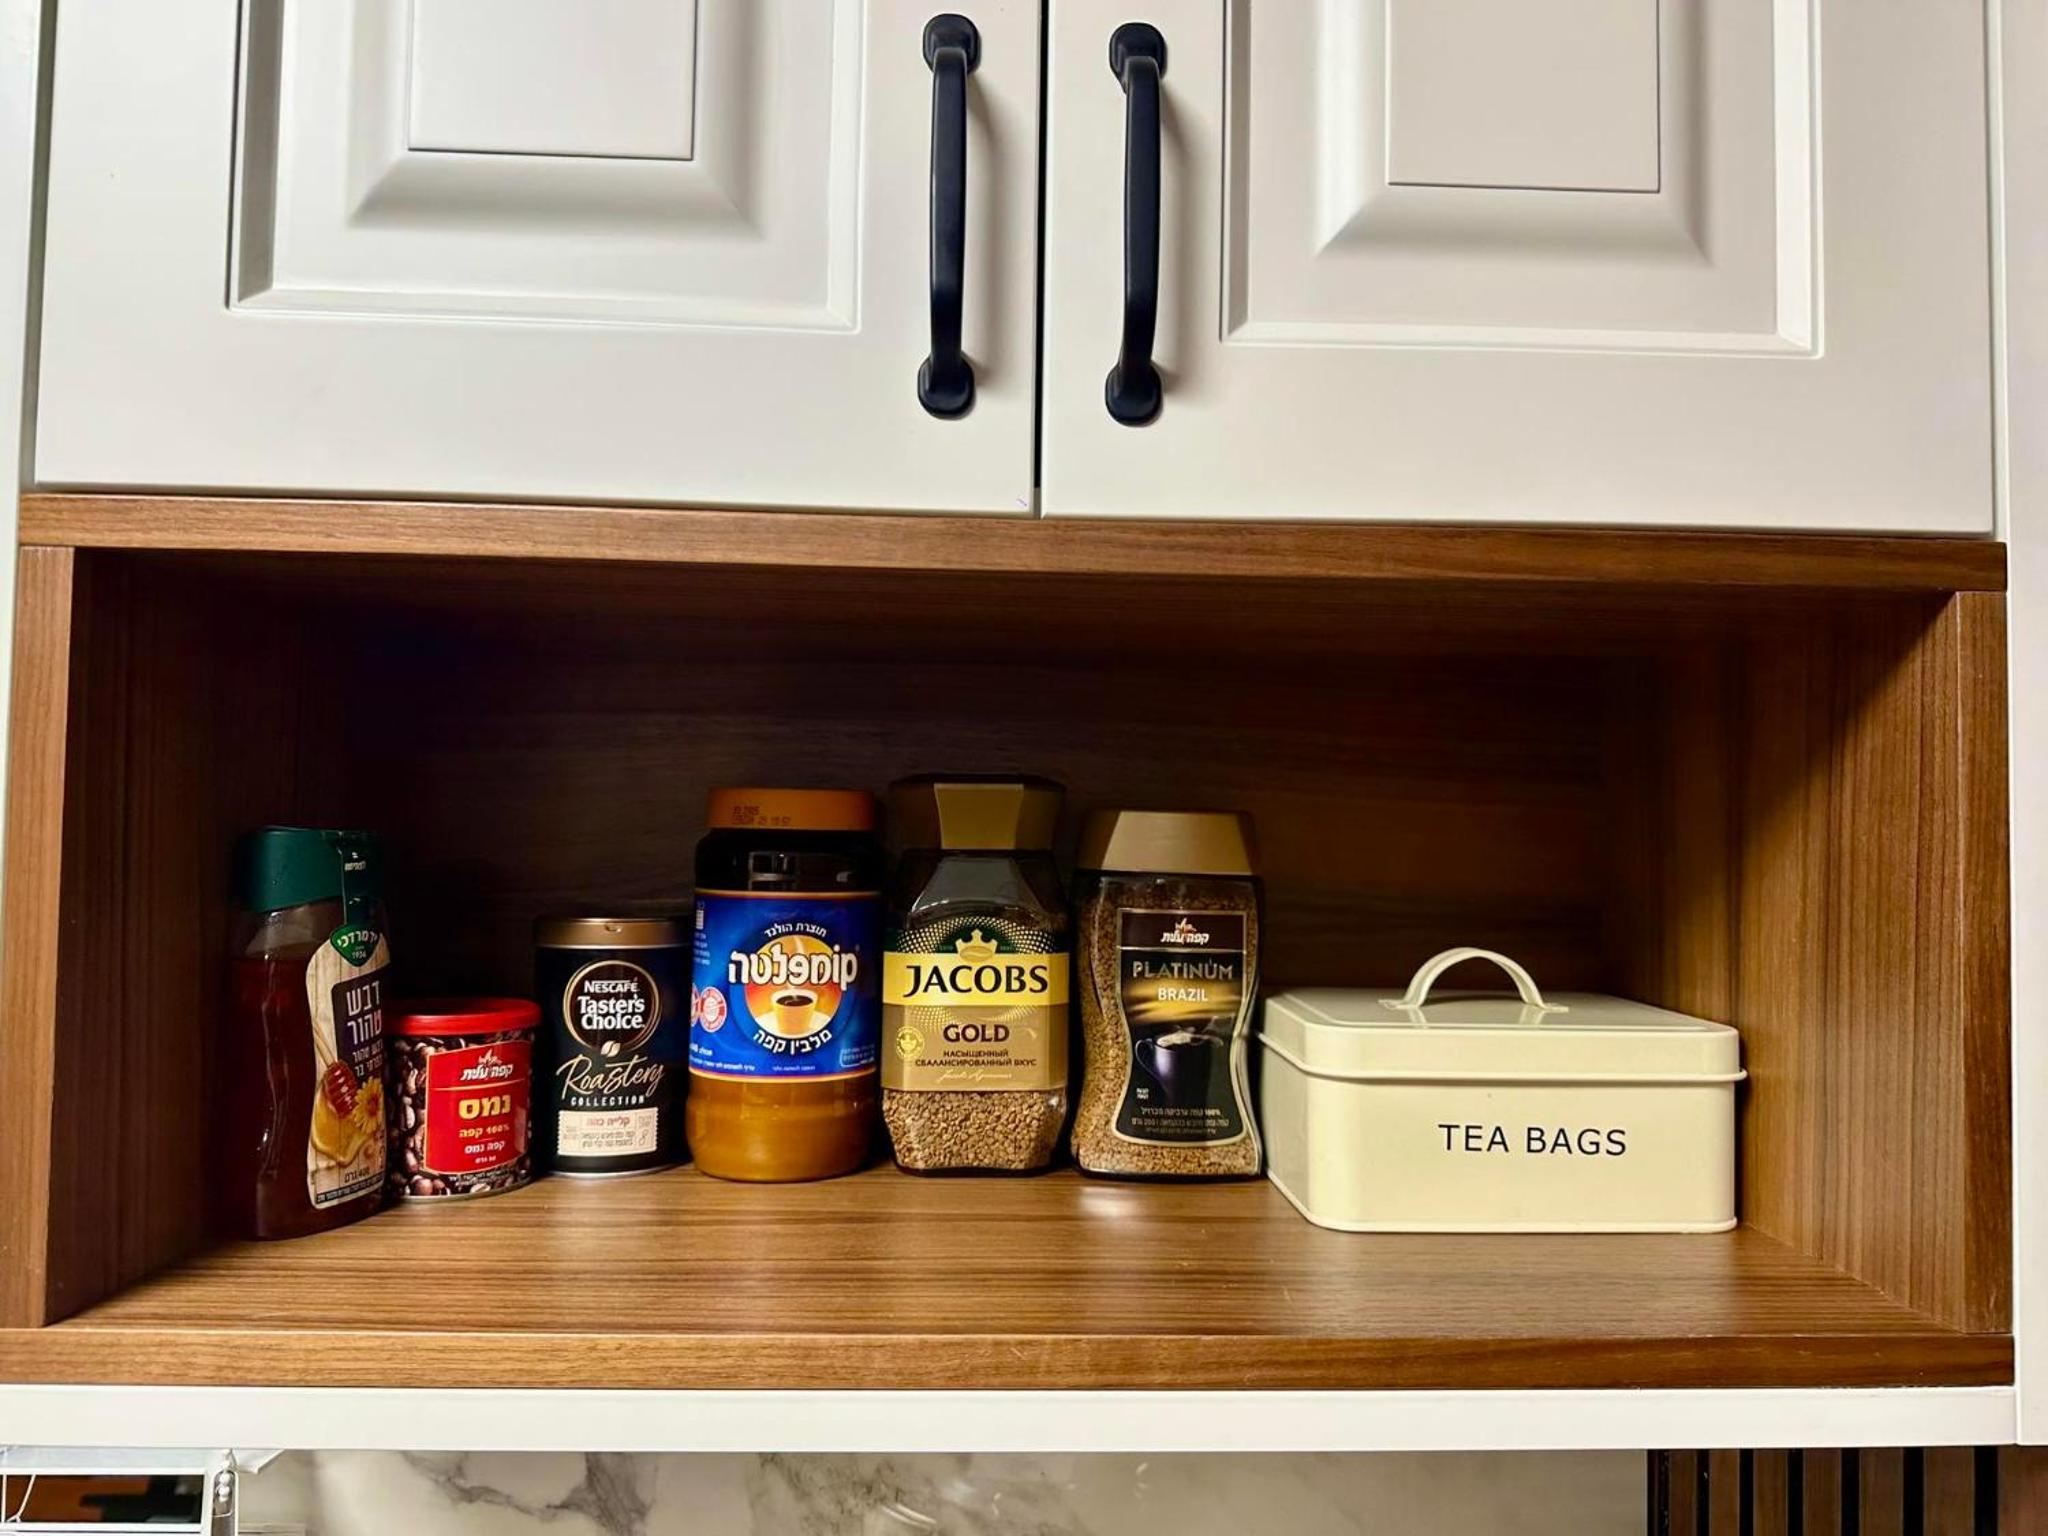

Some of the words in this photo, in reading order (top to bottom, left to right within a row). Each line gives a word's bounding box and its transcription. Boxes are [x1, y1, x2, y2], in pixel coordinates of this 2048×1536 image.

[764, 922, 793, 938] הולנד
[795, 922, 828, 938] תוצרת
[1186, 931, 1210, 945] קפה
[336, 930, 369, 948] מרדכי
[728, 943, 858, 991] קומפלטה
[1132, 959, 1233, 980] PLATINUM
[584, 977, 639, 994] NESCAFÉ
[903, 965, 1049, 998] JACOBS
[346, 981, 380, 1017] דבש
[1157, 987, 1208, 1002] BRAZIL
[577, 994, 646, 1014] Taster's
[347, 1009, 383, 1045] טהור
[581, 1013, 645, 1030] Choice
[753, 1029, 787, 1053] קפה
[943, 1023, 1010, 1043] GOLD
[790, 1029, 833, 1055] מלבין
[943, 1048, 1009, 1058] НАСЫЩЕННЫЙ
[915, 1057, 1012, 1067] СБАЛАНСИРОВАННЫЙ
[1014, 1058, 1037, 1067] ВКУС
[490, 1063, 514, 1079] קפה
[556, 1053, 664, 1100] Roastery
[458, 1094, 511, 1120] נמס
[571, 1095, 645, 1107] COLLECTION
[458, 1127, 483, 1139] קפה
[486, 1123, 510, 1135] 100%
[486, 1141, 506, 1152] קפה
[1438, 1123, 1509, 1153] TEA
[1526, 1126, 1627, 1157] BAGS
[464, 1145, 485, 1155] נמס
